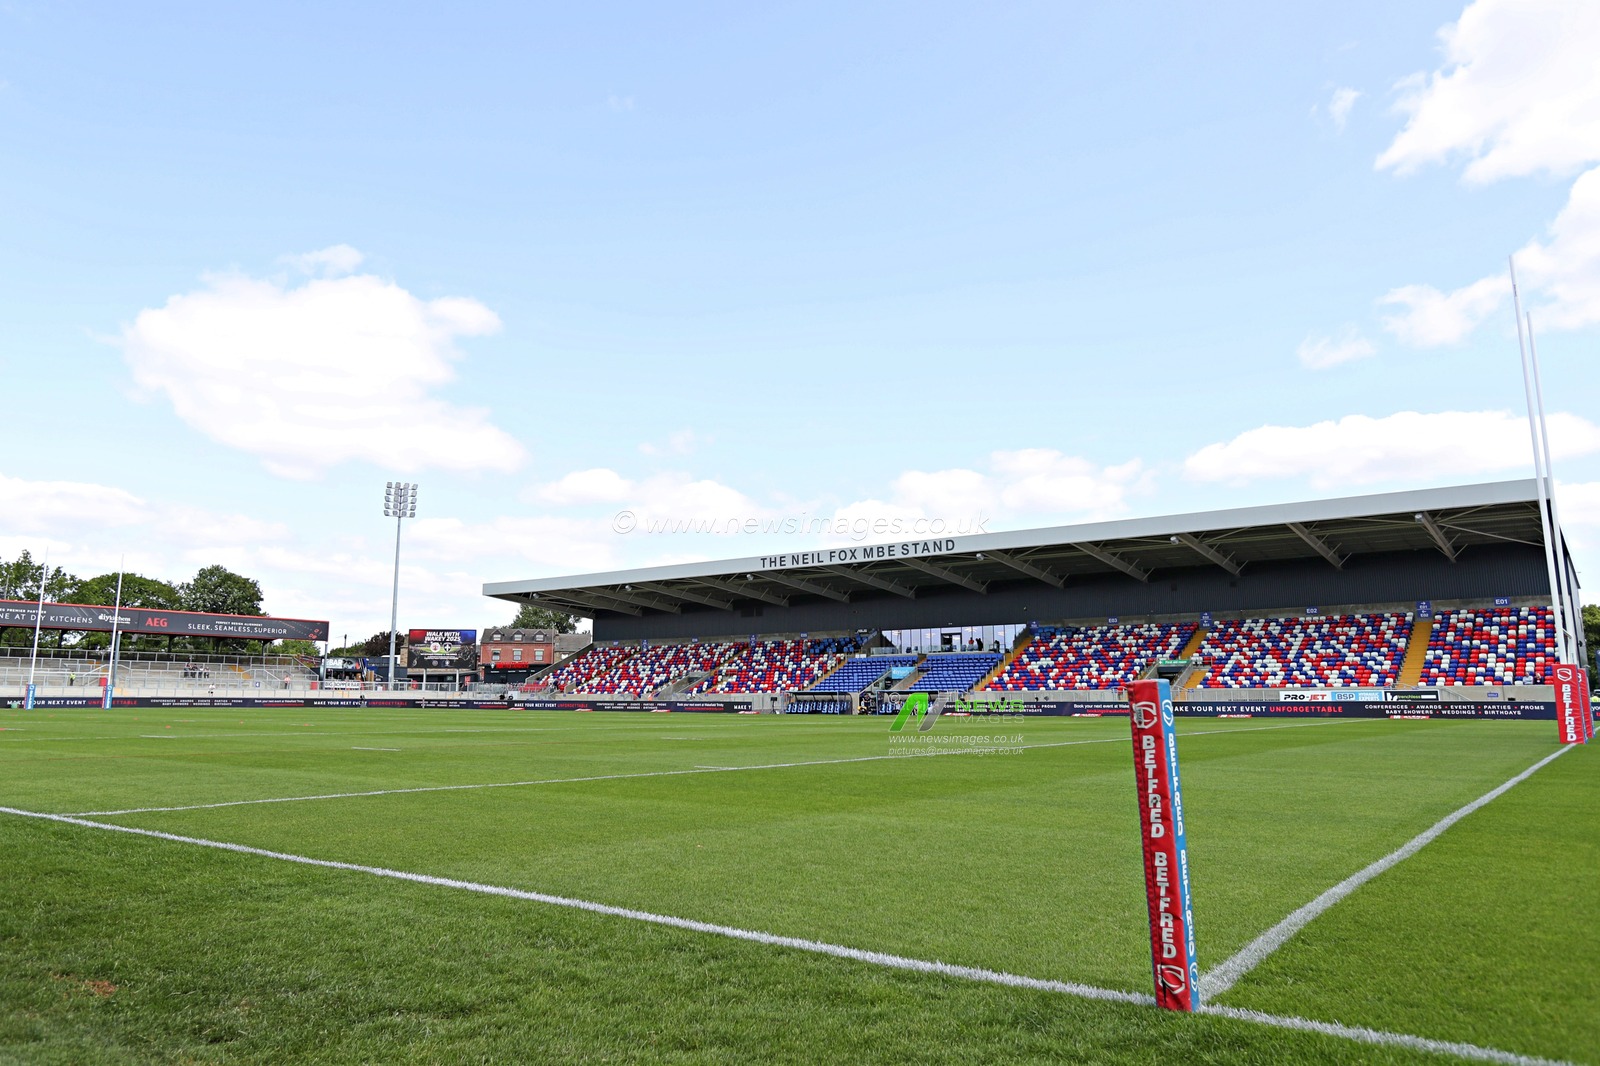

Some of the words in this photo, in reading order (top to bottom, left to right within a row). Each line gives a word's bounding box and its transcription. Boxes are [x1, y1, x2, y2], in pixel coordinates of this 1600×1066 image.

[760, 556, 786, 568] THE
[791, 552, 823, 565] NEIL
[829, 549, 857, 562] FOX
[863, 545, 895, 559] MBE
[901, 539, 955, 556] STAND
[50, 615, 93, 624] KITCHENS
[145, 617, 168, 627] AEG
[254, 626, 287, 634] SUPERIOR
[1561, 683, 1577, 742] BETFRED
[1142, 735, 1165, 838] BETFRED
[1168, 733, 1184, 837] BETFRED
[1154, 852, 1177, 958] BETFRED
[1180, 849, 1194, 957] BETFRED
